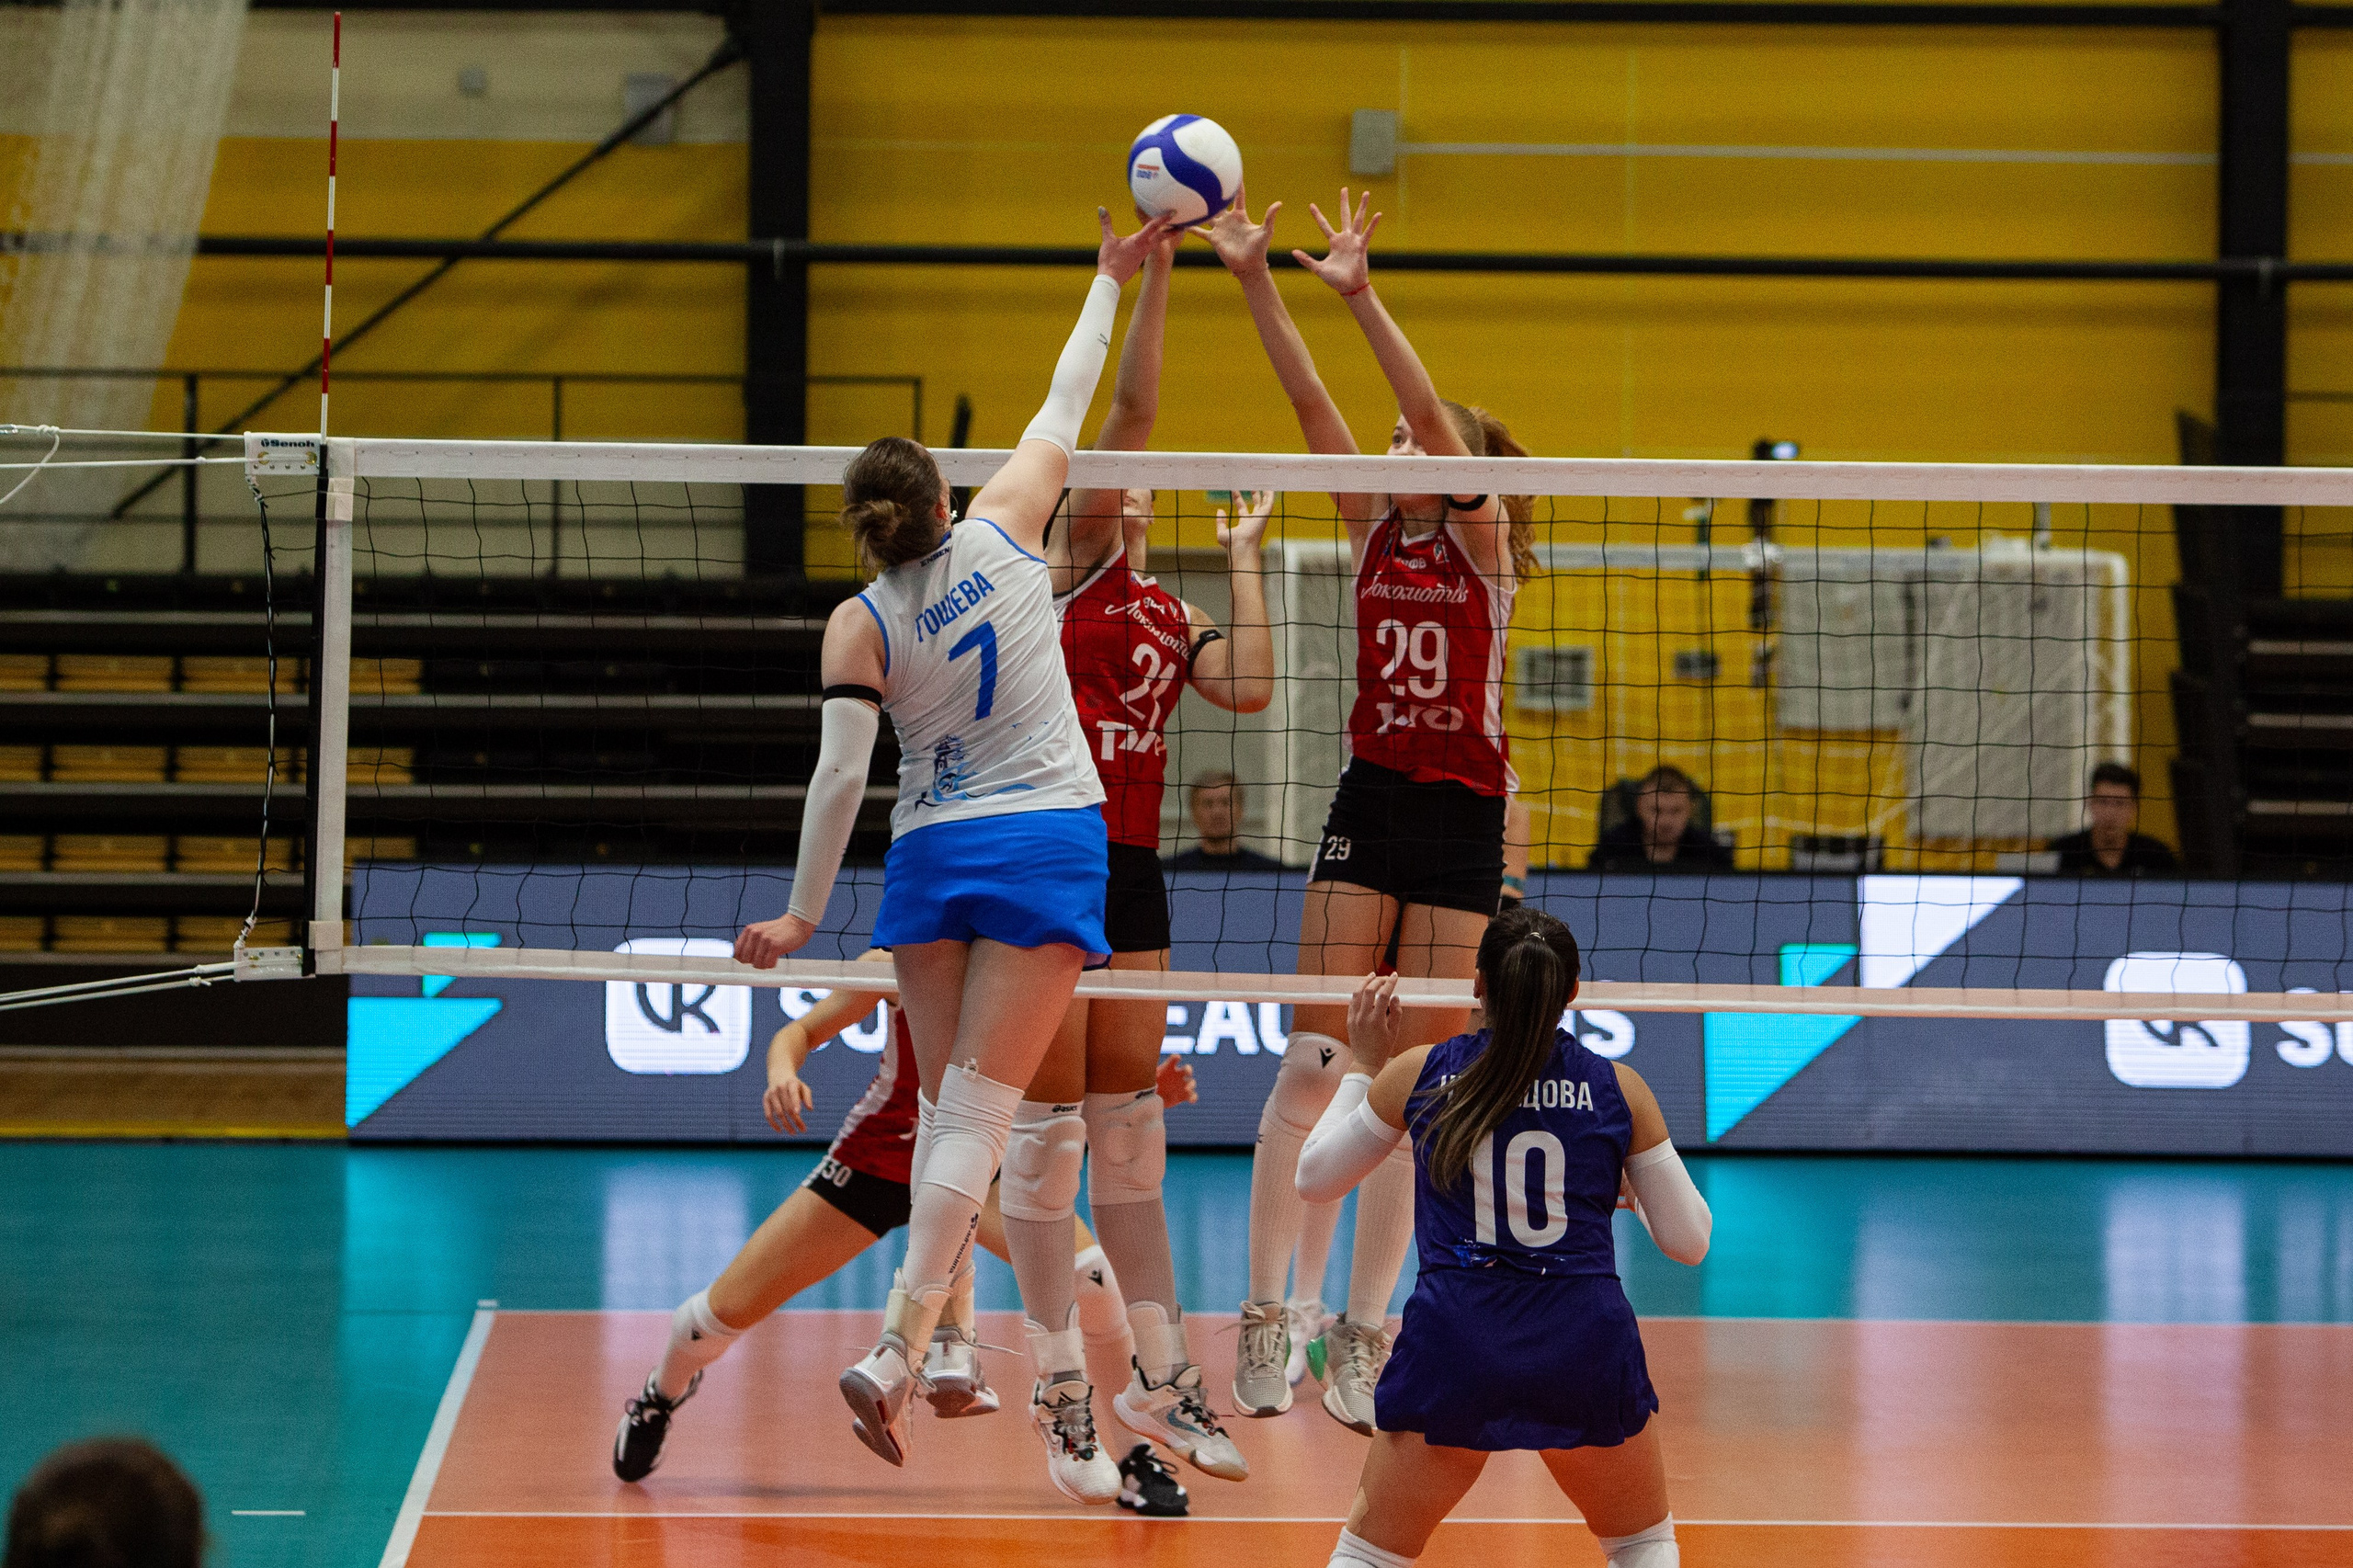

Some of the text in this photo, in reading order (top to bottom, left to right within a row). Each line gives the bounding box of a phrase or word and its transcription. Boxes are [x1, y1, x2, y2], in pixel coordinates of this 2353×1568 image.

[270, 439, 314, 448] Senoh
[915, 570, 995, 642] ГОШЕВА
[948, 619, 998, 722] 7
[1376, 619, 1449, 699] 29
[1324, 835, 1351, 860] 29
[1471, 1130, 1568, 1248] 10
